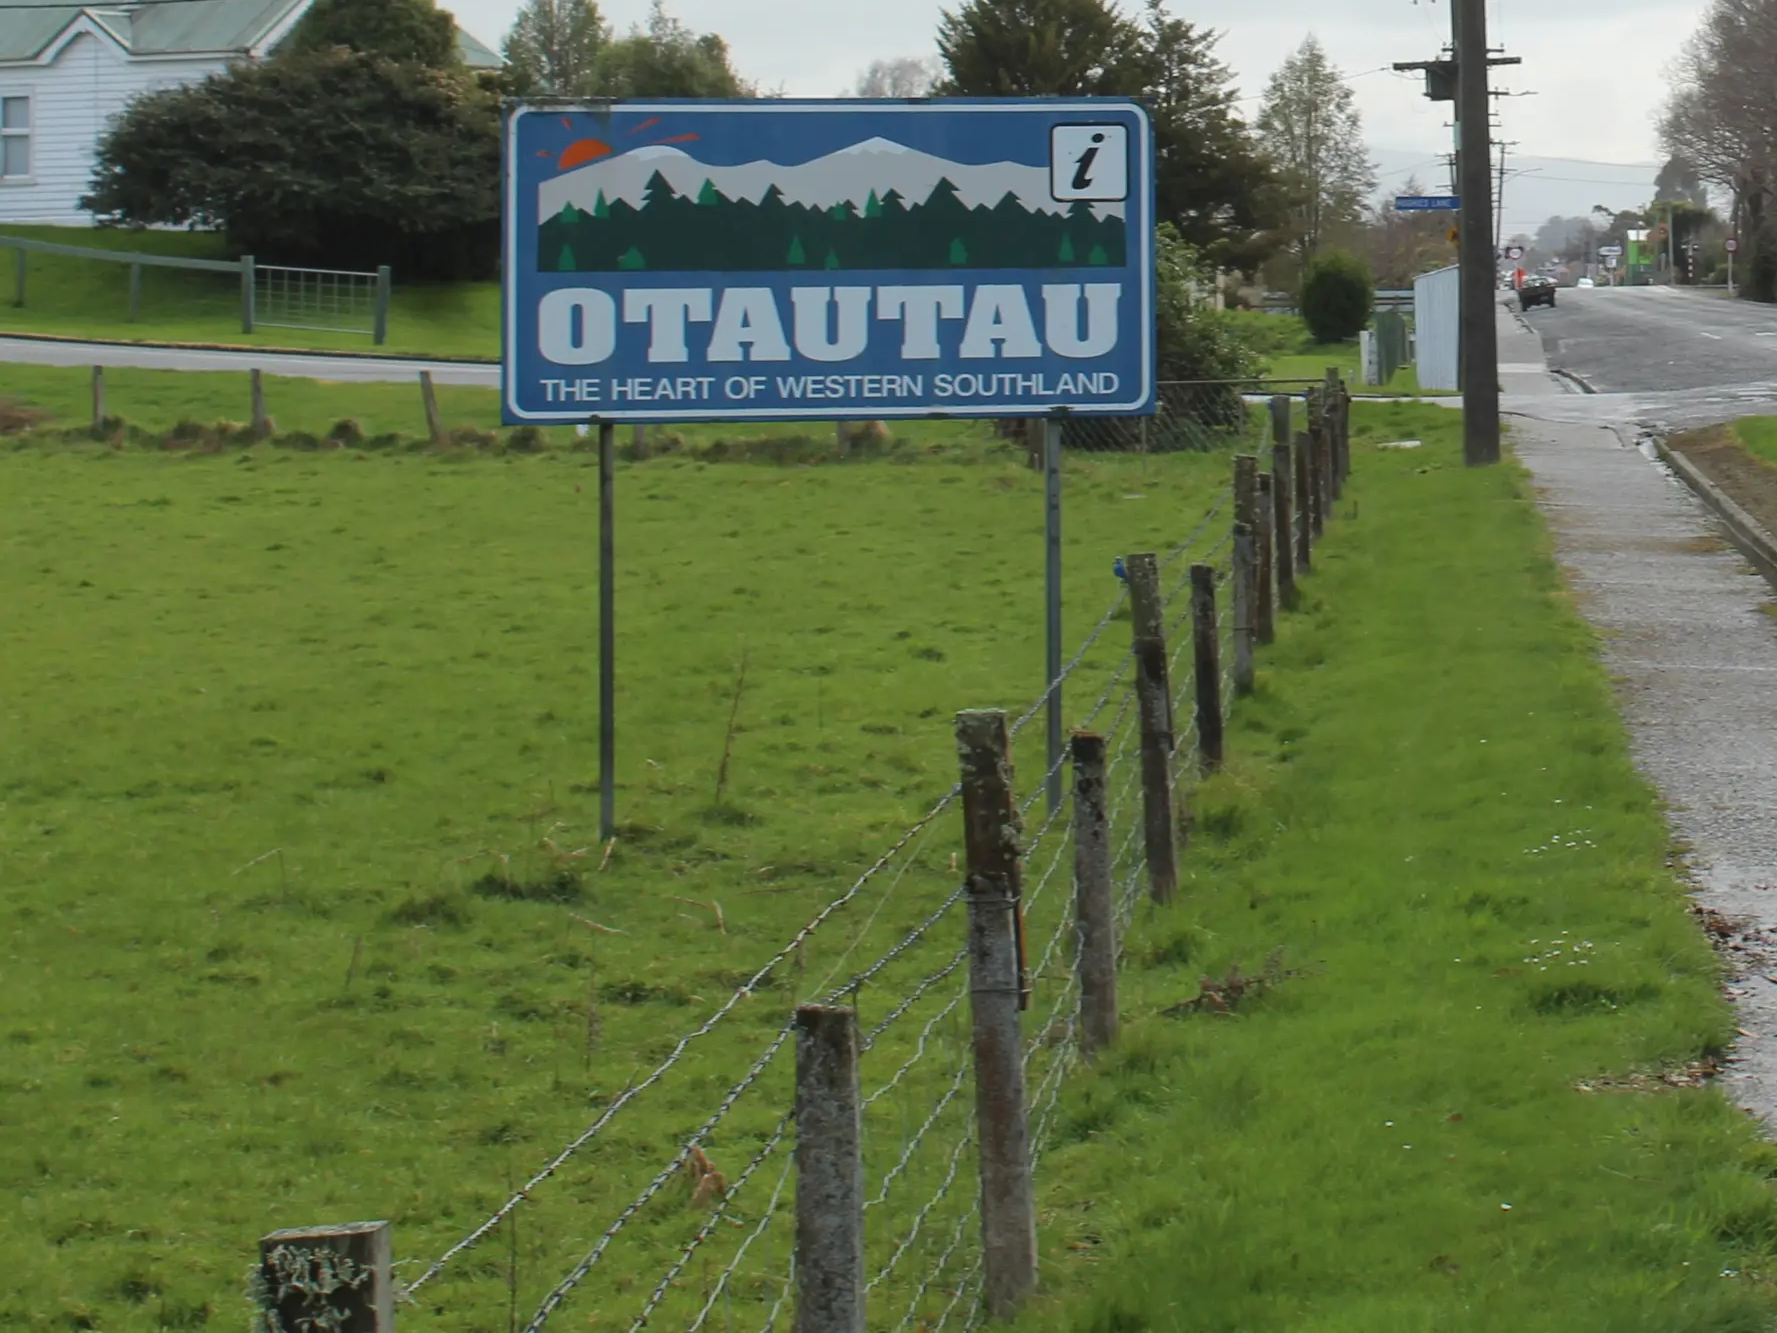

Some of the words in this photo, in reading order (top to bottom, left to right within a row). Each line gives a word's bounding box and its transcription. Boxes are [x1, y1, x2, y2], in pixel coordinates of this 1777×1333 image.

[1071, 133, 1105, 189] i
[538, 283, 1121, 365] OTAUTAU
[540, 378, 600, 401] THE
[612, 377, 715, 400] HEART
[725, 376, 766, 399] OF
[777, 375, 922, 398] WESTERN
[934, 372, 1118, 397] SOUTHLAND
